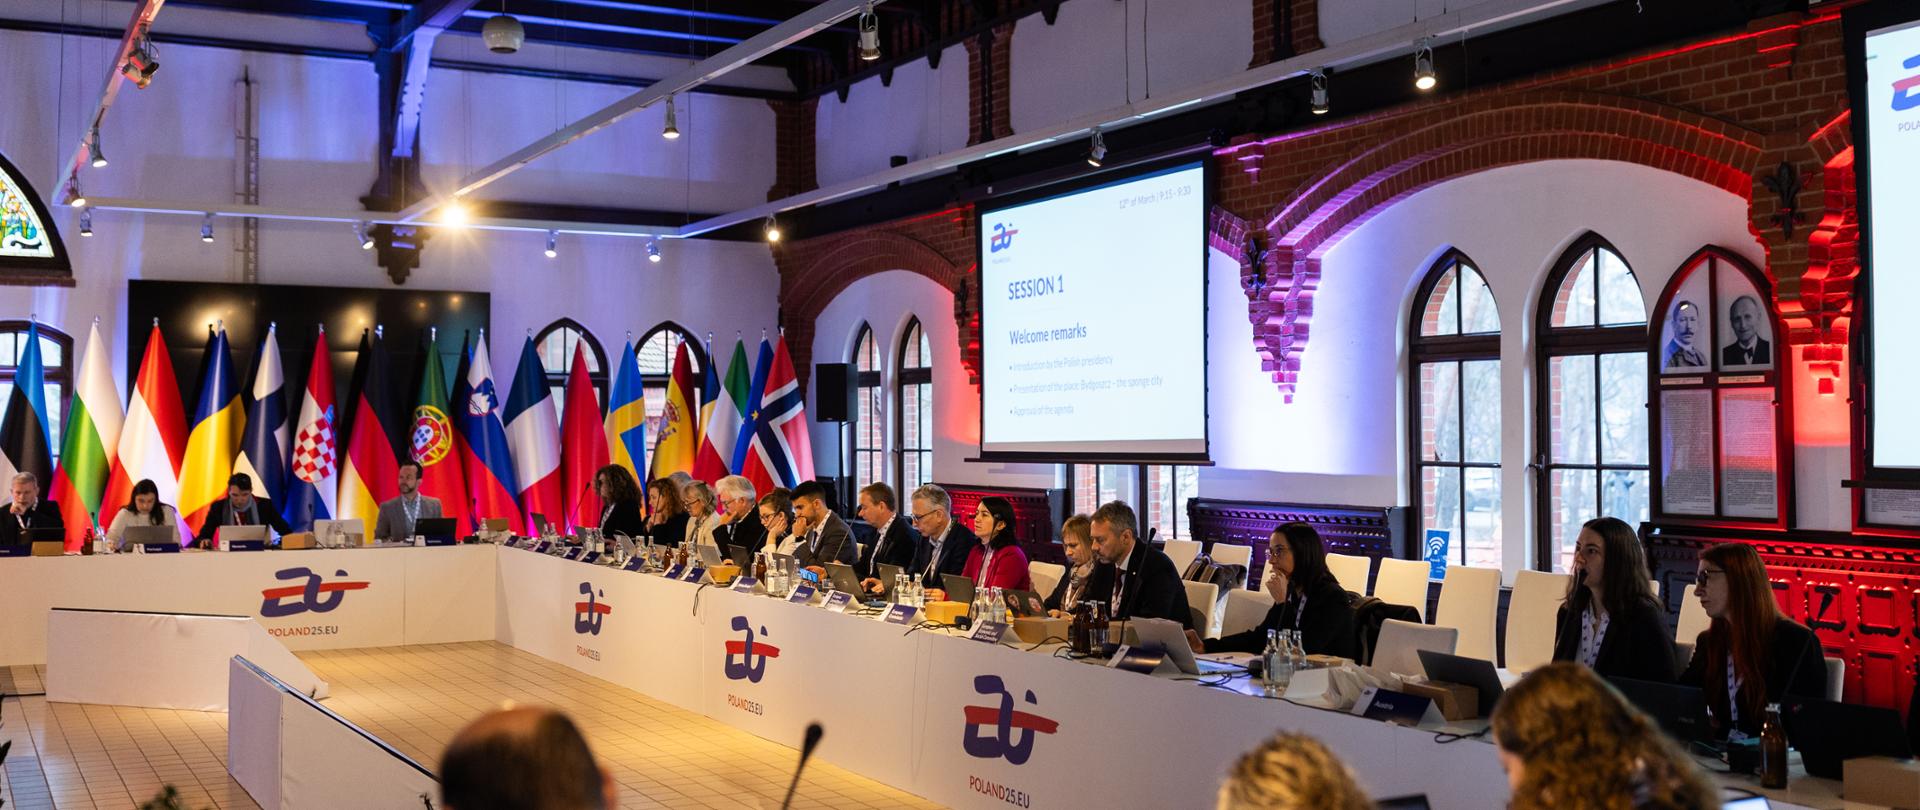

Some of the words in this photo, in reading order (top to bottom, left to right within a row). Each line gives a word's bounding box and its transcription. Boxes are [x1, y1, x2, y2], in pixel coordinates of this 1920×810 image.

[1137, 193, 1155, 205] March
[1008, 275, 1054, 301] SESSION
[1058, 274, 1064, 293] 1
[1009, 328, 1049, 345] Welcome
[1051, 321, 1087, 341] remarks
[1054, 358, 1063, 368] the
[1081, 355, 1113, 368] presidency
[1117, 378, 1127, 388] the
[1128, 377, 1150, 389] sponge
[1151, 374, 1163, 387] city
[268, 625, 339, 637] POLAND25.EU
[727, 693, 763, 717] POLAND25.EU
[969, 775, 1031, 809] POLAND25.EU
